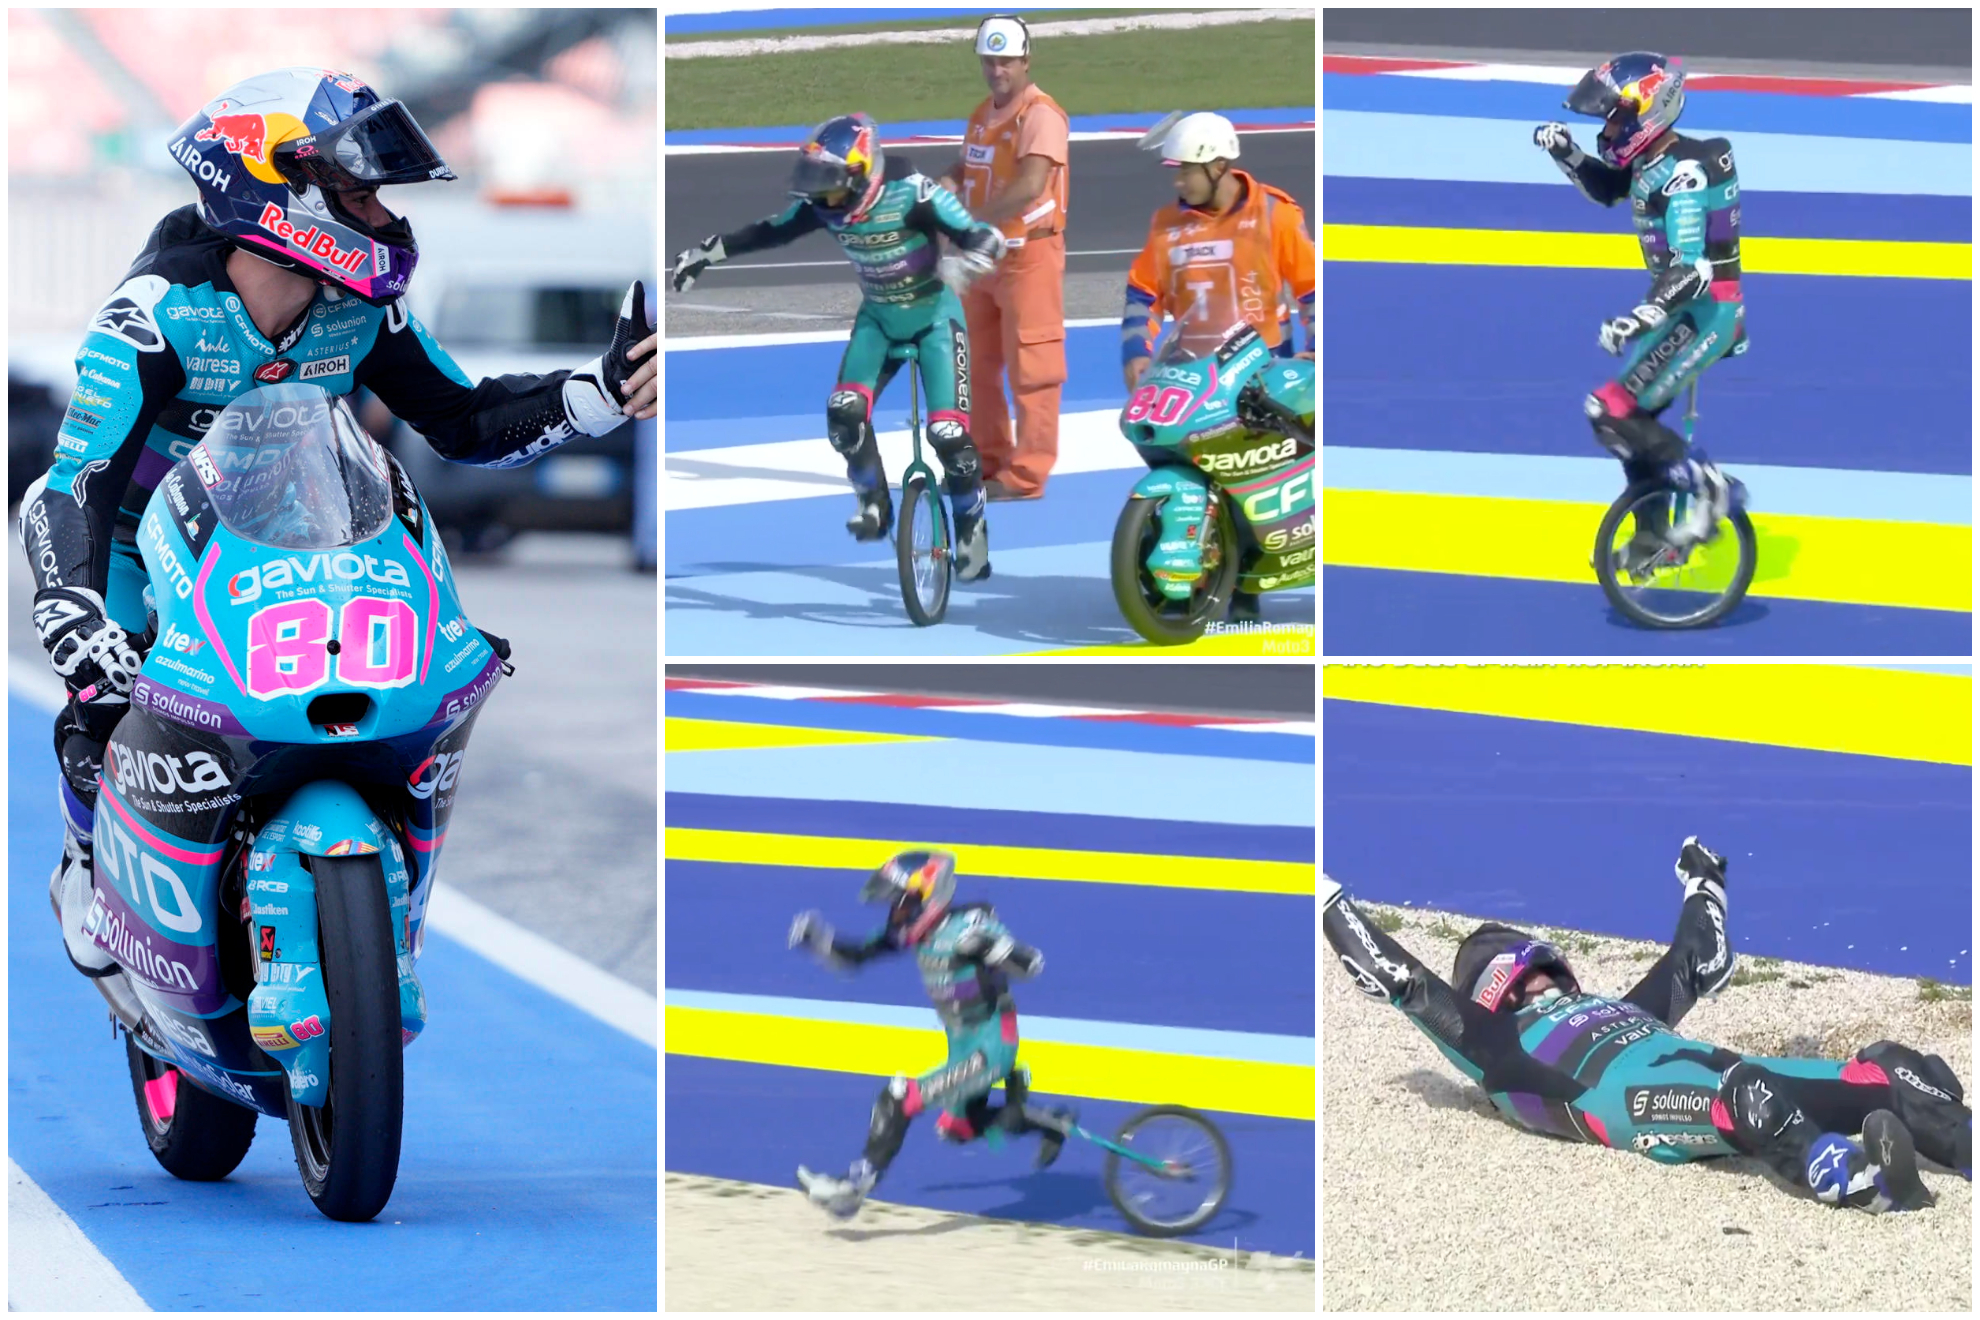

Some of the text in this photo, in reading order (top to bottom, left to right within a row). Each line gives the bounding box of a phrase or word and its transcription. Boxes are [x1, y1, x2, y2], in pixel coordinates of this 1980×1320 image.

[170, 136, 231, 193] AIROH
[377, 247, 387, 271] AIROH
[1186, 281, 1214, 321] T
[1240, 270, 1264, 323] 2024
[234, 313, 275, 355] CFMOTO
[326, 315, 367, 333] solunion
[87, 350, 130, 371] CFMOTO
[307, 341, 350, 357] ASTERIUS
[303, 358, 347, 377] AIROH
[1126, 384, 1194, 427] 80
[191, 446, 221, 485] WRS
[1194, 437, 1297, 472] gaviota
[146, 513, 193, 599] CFMOTO
[229, 552, 411, 606] gaviota
[276, 590, 294, 600] The
[297, 588, 316, 597] Sun
[319, 585, 326, 593] &
[328, 584, 363, 593] Shutter
[247, 595, 419, 702] 80
[444, 638, 480, 673] azulmarino
[155, 655, 215, 685] azulmarino
[79, 684, 97, 702] 80
[462, 666, 502, 710] solunion
[151, 692, 222, 729] solunion
[108, 740, 231, 796] gaviota
[157, 800, 184, 814] Shutter
[186, 793, 242, 814] Specialists
[257, 880, 289, 893] RCB
[101, 910, 199, 991] solunion
[291, 1015, 325, 1040] 80
[1652, 1089, 1710, 1112] solunion
